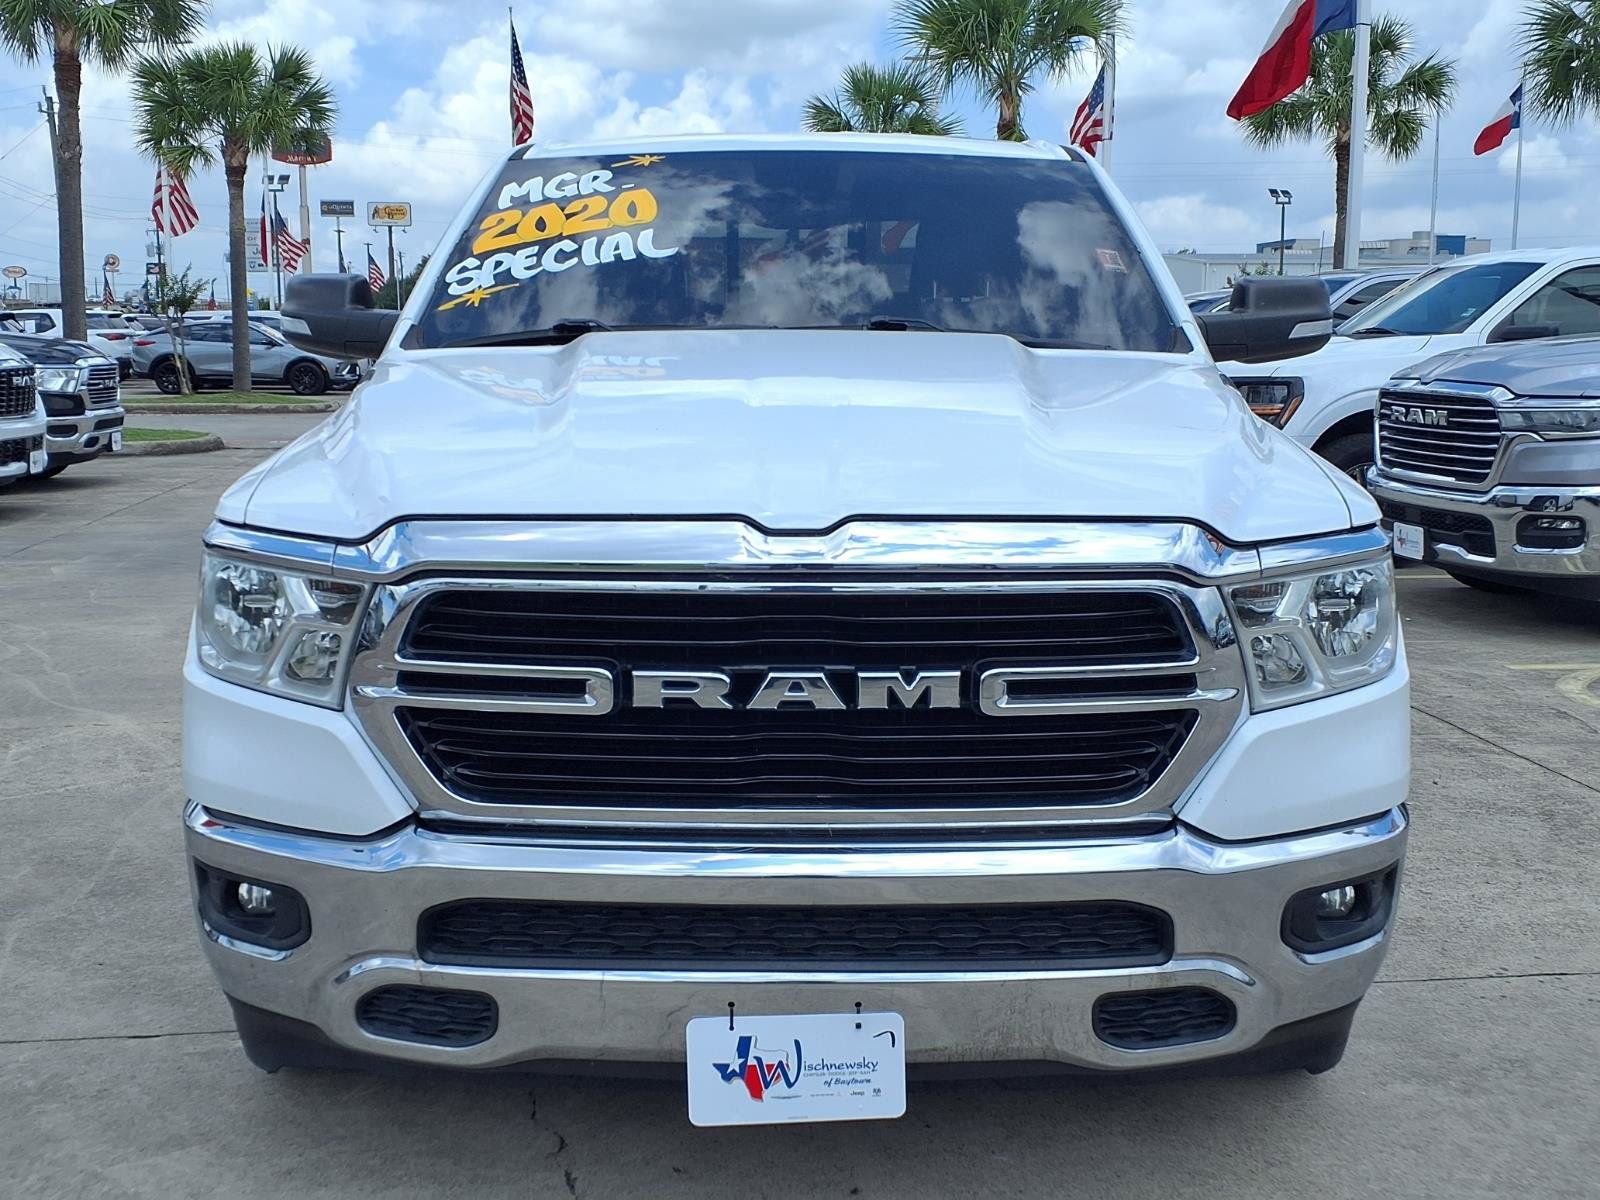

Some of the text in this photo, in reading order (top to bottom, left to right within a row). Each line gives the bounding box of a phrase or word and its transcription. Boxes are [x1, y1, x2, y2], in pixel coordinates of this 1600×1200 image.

[472, 188, 658, 255] 2020
[445, 229, 679, 296] SPECIAL
[1391, 405, 1448, 426] RAM
[632, 670, 961, 710] RAM
[753, 1039, 879, 1089] Wischnewsky
[823, 1077, 833, 1088] of
